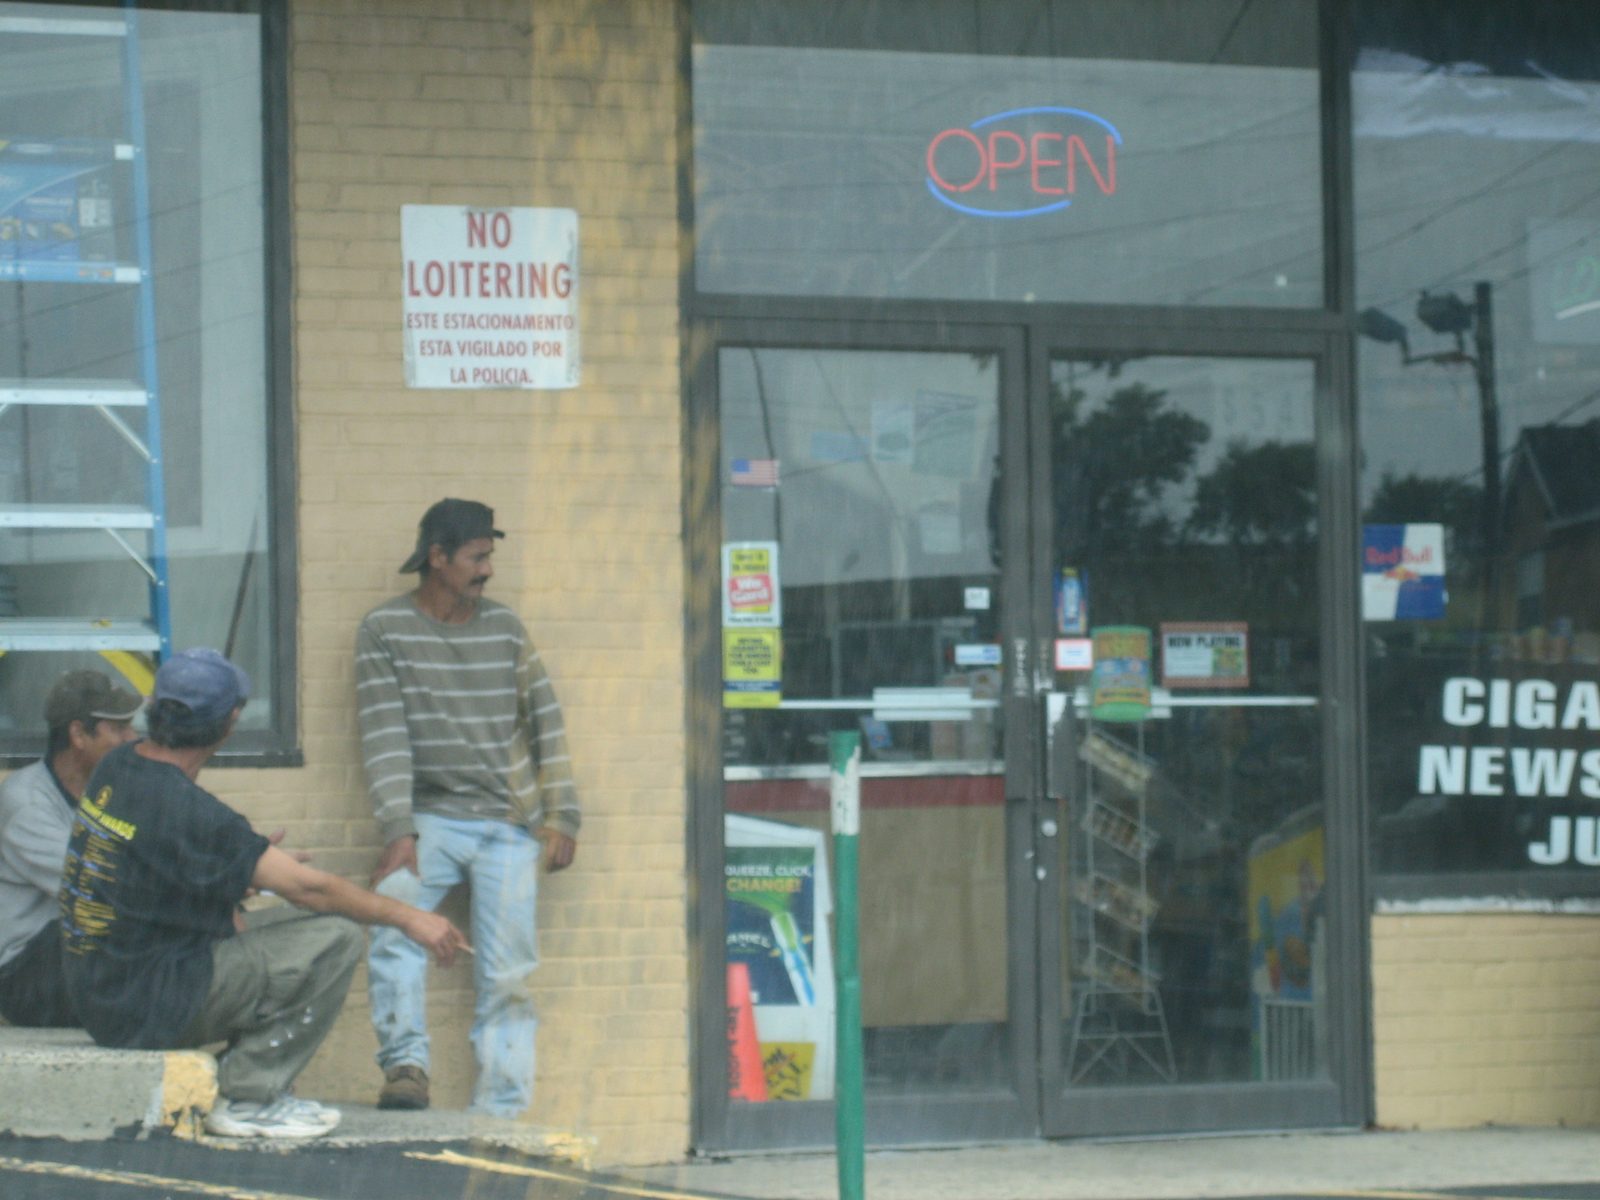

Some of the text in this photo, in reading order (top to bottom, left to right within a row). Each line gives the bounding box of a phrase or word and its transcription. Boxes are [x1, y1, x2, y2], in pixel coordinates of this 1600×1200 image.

[926, 128, 1116, 196] OPEN
[467, 212, 511, 248] NO
[408, 260, 572, 298] LOITERING
[407, 313, 575, 330] ESTE ESTACIONAMENTO
[419, 340, 562, 357] ESTA VIGILADO POR
[450, 368, 467, 384] LA
[1366, 544, 1433, 566] Red Bull
[1442, 677, 1600, 730] CIGA
[1527, 815, 1600, 866] JU
